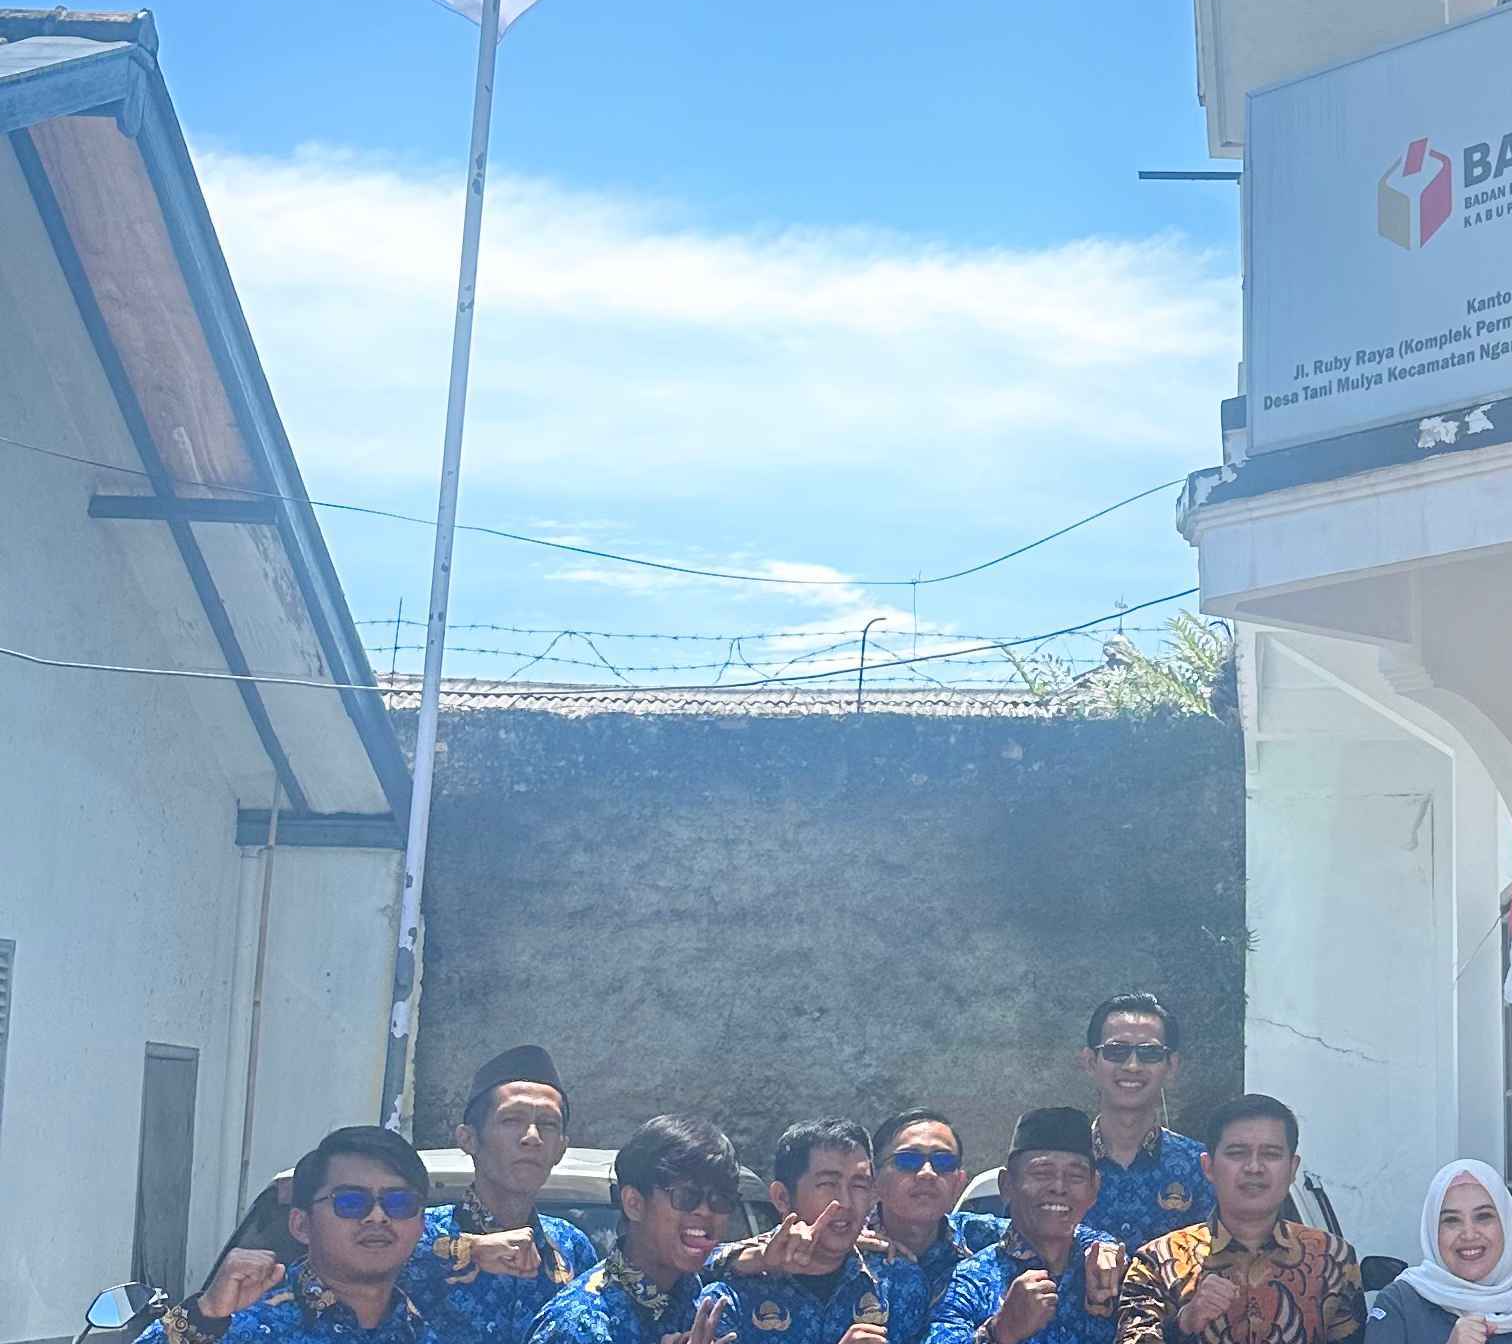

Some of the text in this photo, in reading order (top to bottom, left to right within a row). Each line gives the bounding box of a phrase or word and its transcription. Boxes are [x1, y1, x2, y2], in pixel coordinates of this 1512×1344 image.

[1464, 184, 1506, 210] BADAN
[1313, 354, 1350, 376] Ruby
[1355, 344, 1394, 366] Raya
[1399, 324, 1472, 358] (Komplek
[1263, 390, 1299, 410] Desa
[1302, 379, 1333, 402] Tani
[1336, 369, 1384, 394] Mulya
[1387, 349, 1476, 383] Kecamatan
